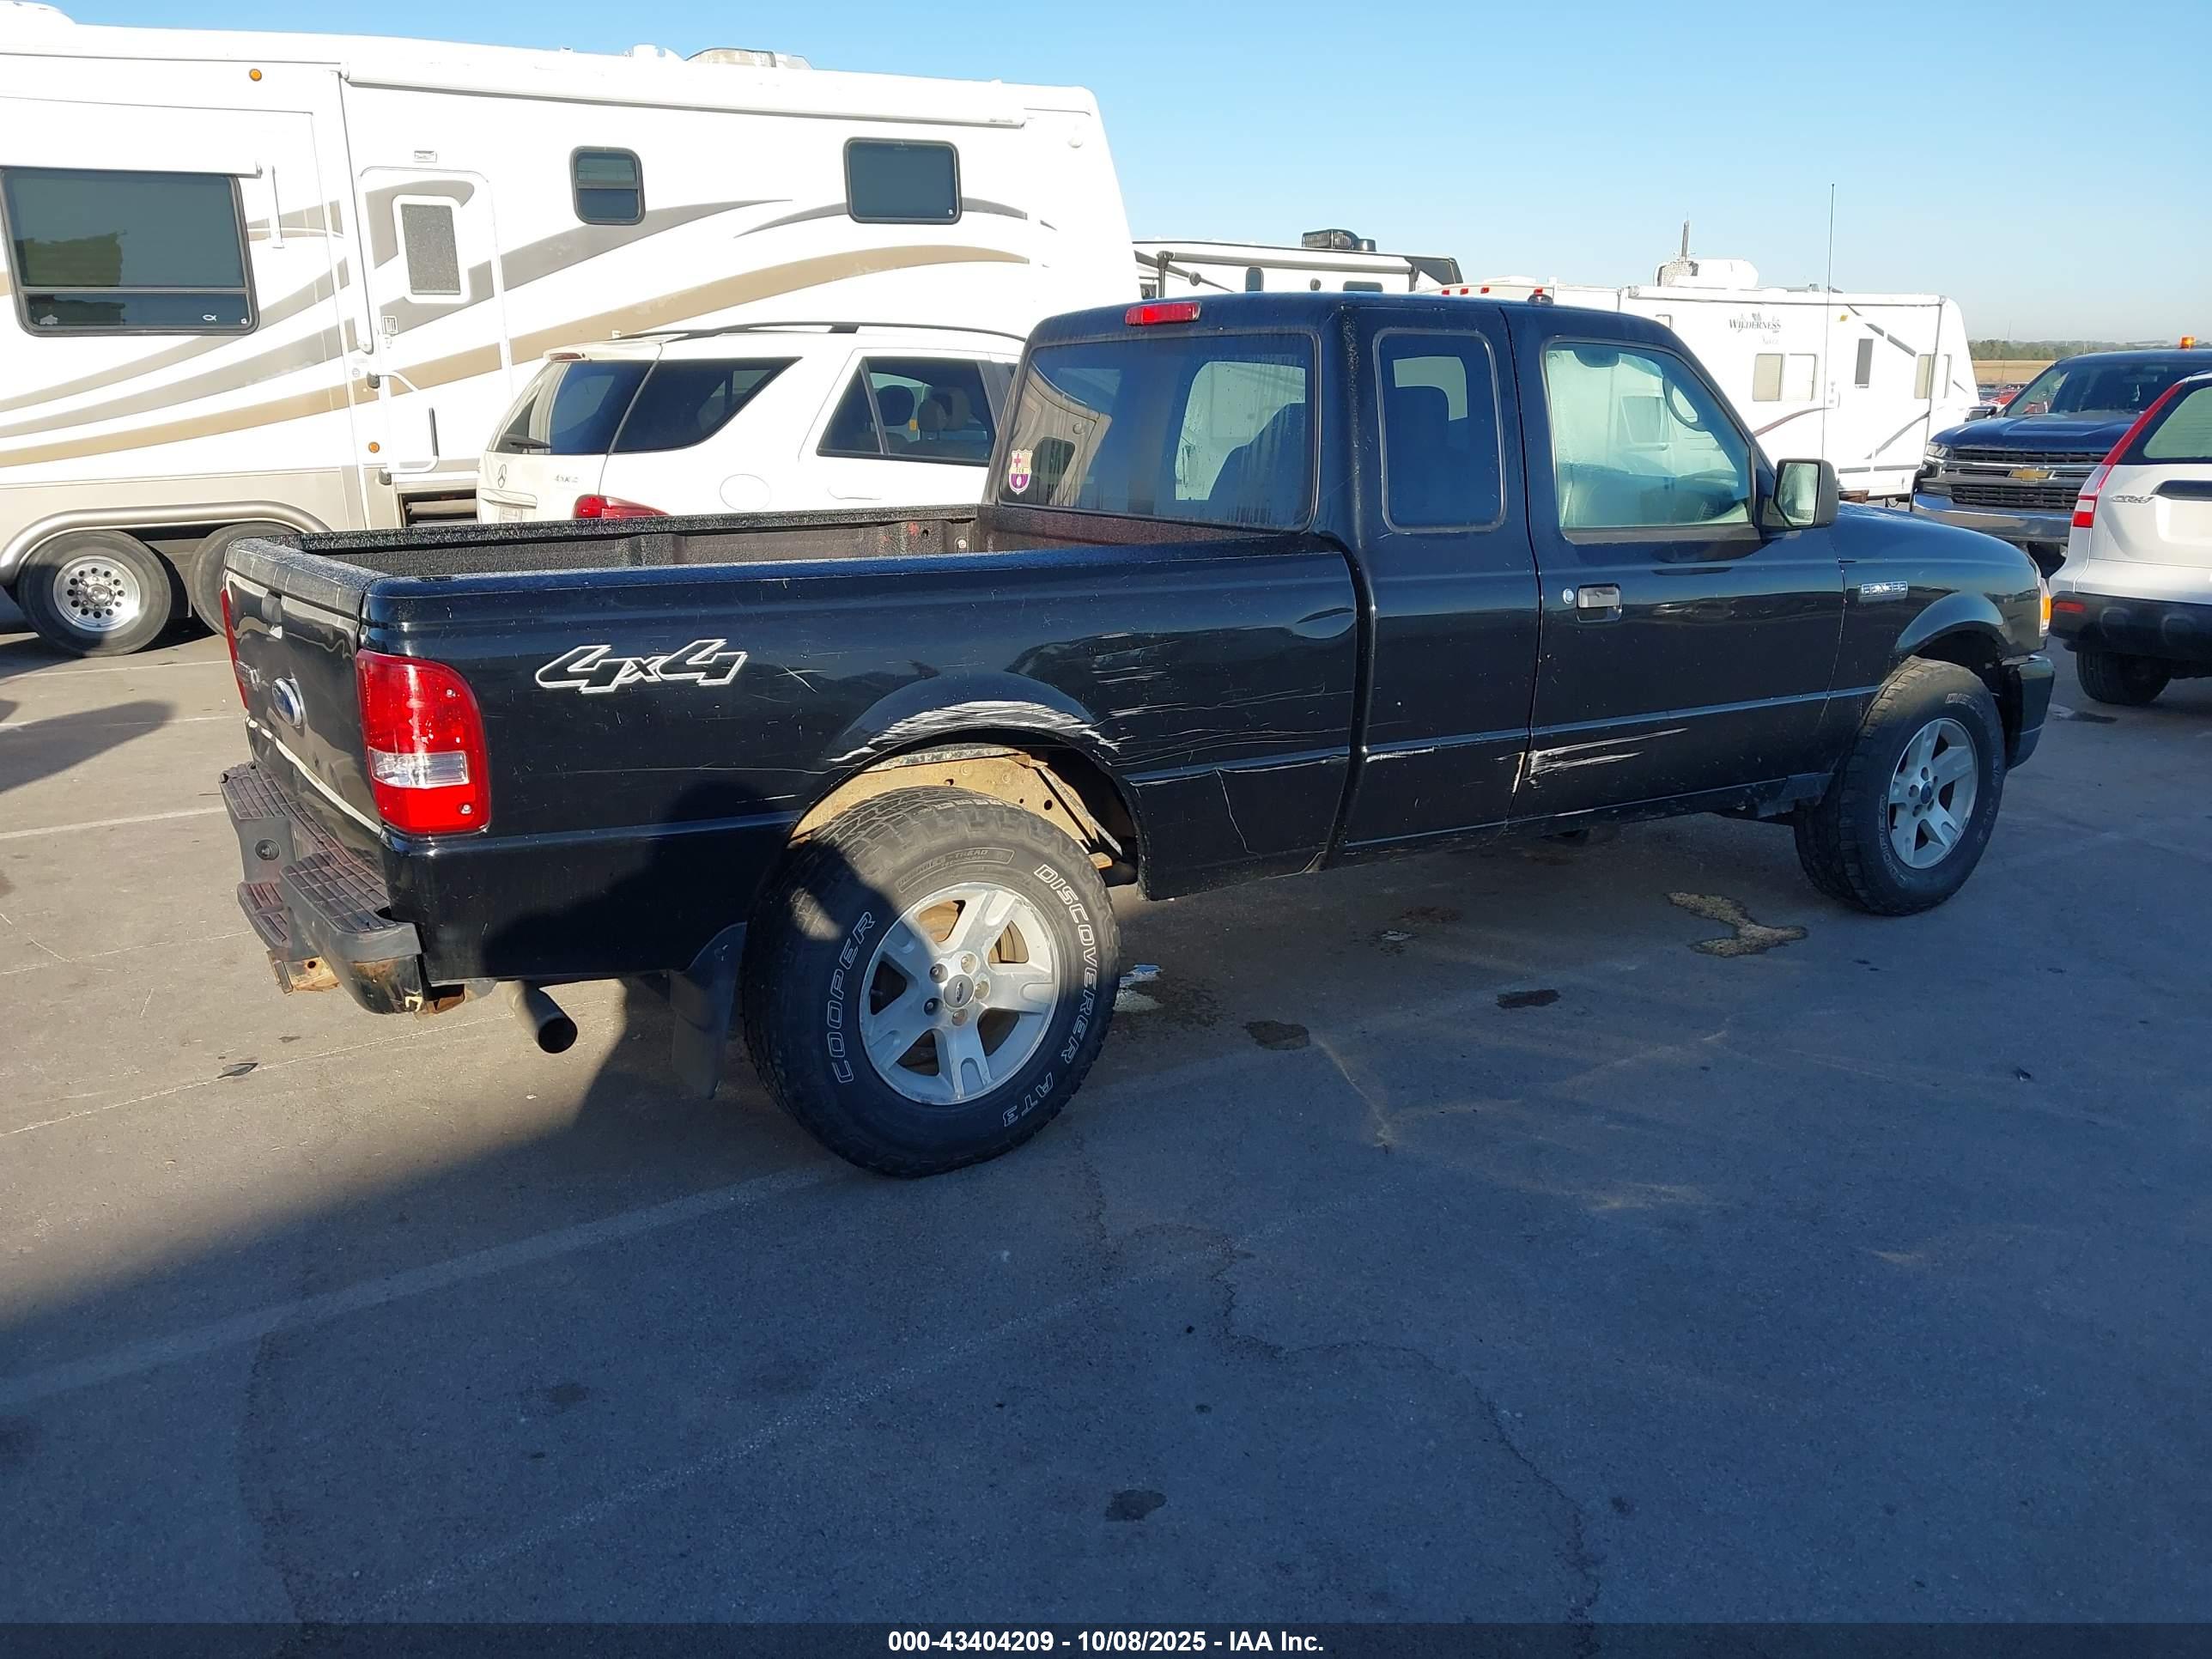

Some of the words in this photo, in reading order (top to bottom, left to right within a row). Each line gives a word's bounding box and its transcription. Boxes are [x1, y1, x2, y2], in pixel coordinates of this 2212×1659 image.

[535, 638, 749, 695] 4x4
[828, 911, 876, 1084] COOPER
[1033, 864, 1100, 1065] DISCOVERER
[1003, 1072, 1055, 1127] AT3
